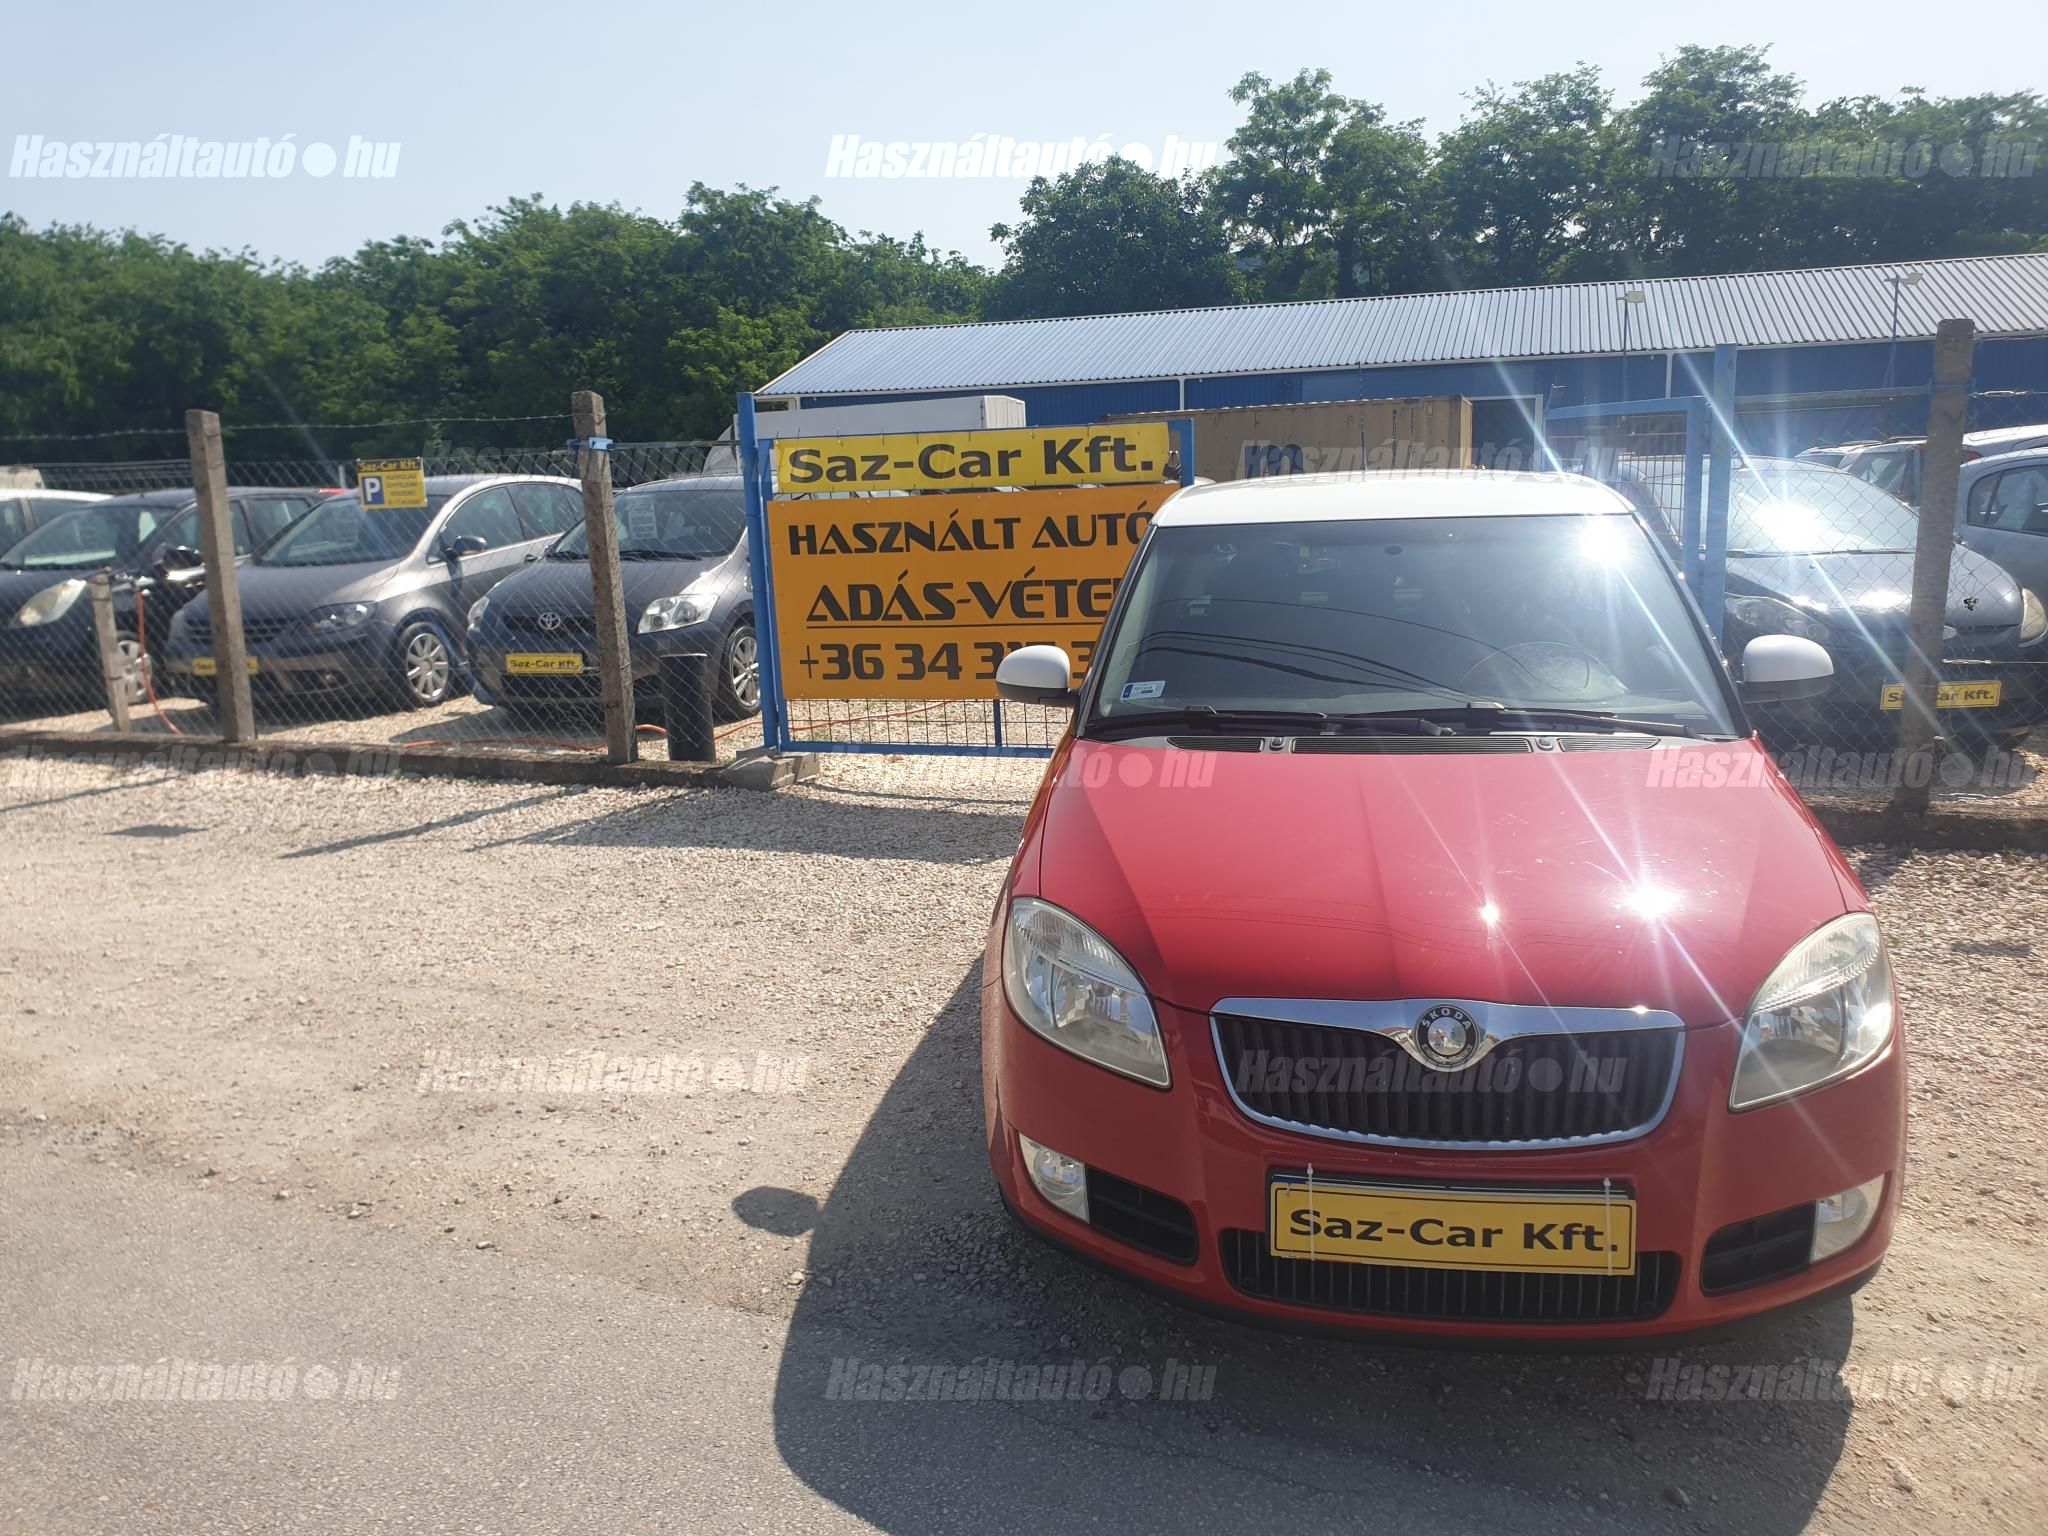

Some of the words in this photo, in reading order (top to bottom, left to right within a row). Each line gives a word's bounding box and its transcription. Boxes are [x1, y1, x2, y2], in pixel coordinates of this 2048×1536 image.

[788, 443, 1022, 483] Saz-Car
[1043, 435, 1154, 475] Kft.
[788, 508, 1021, 556] HASZNÁLT
[1032, 500, 1154, 549] AUTÓ
[806, 565, 1123, 623] ADÁS-VÉTE
[510, 659, 556, 669] Saz-Car
[558, 659, 580, 670] Kft.
[800, 642, 884, 680] +36
[895, 642, 963, 680] 34
[1963, 689, 1995, 701] Kft.
[1289, 1209, 1504, 1249] Saz-Car
[1522, 1222, 1619, 1252] Kft.
